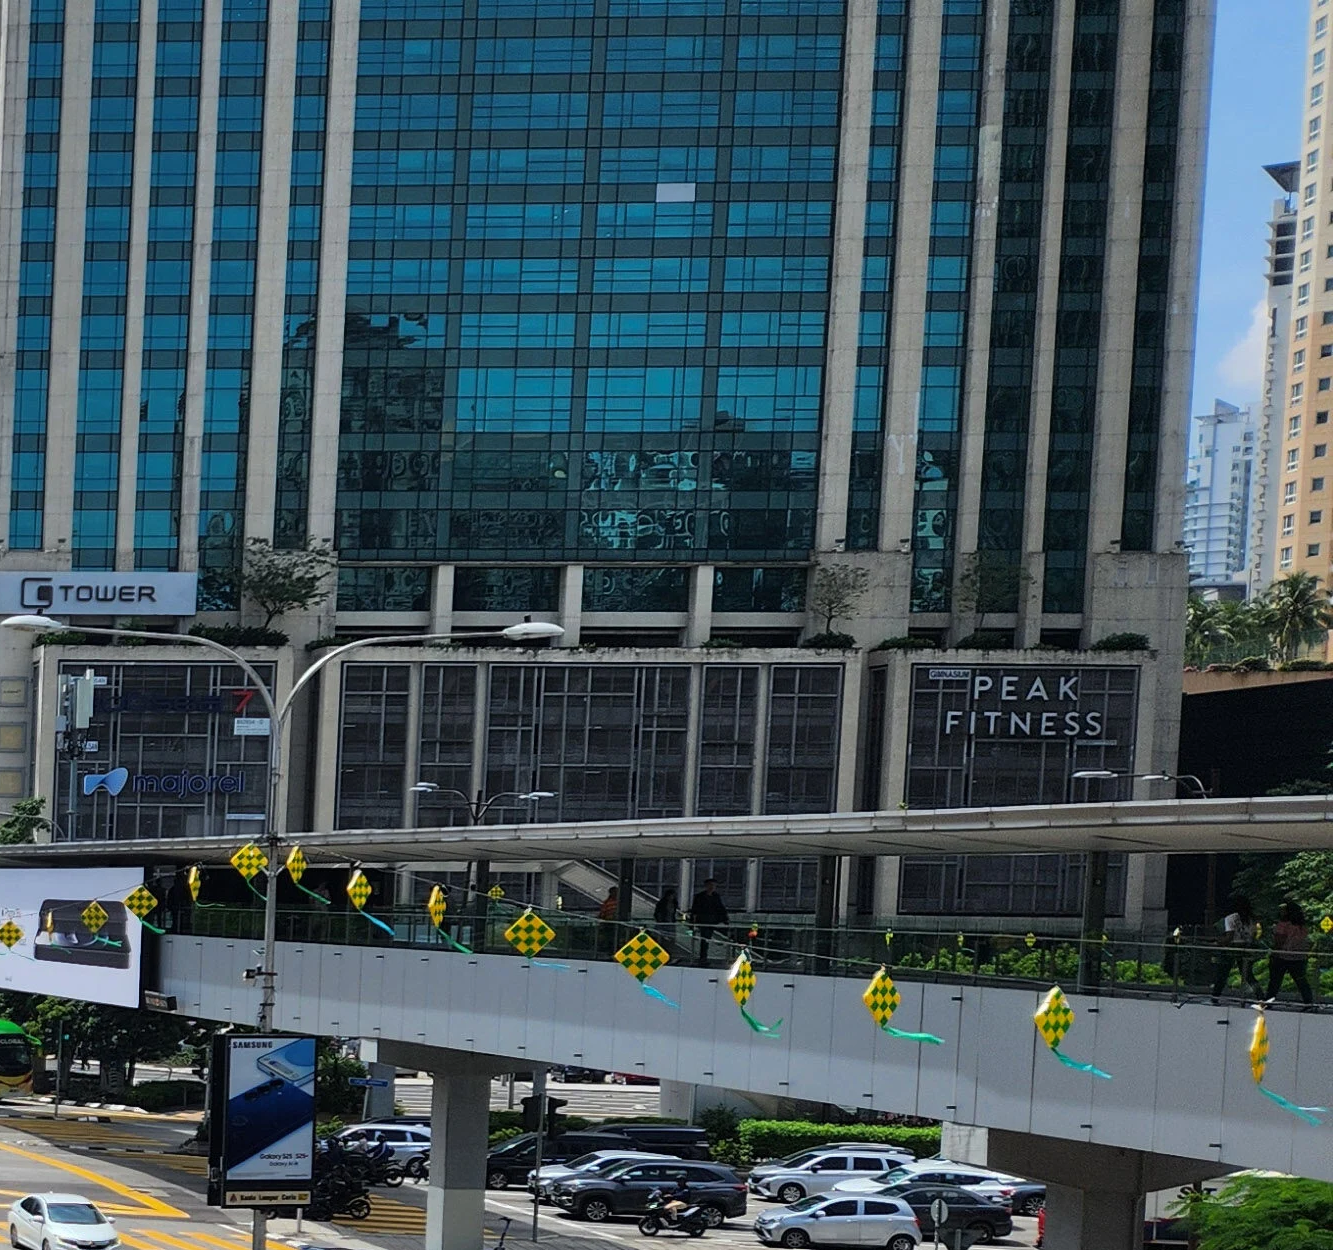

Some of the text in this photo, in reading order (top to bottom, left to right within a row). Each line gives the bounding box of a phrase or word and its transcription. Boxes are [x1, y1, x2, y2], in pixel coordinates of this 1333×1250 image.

[59, 585, 157, 602] TOWER
[930, 670, 970, 679] GIMNASIUM
[974, 676, 1079, 700] PEAK
[945, 711, 1102, 736] FITNESS
[133, 768, 245, 799] majorel
[233, 1041, 273, 1049] SAMSUNG
[260, 1153, 282, 1161] Galaxy
